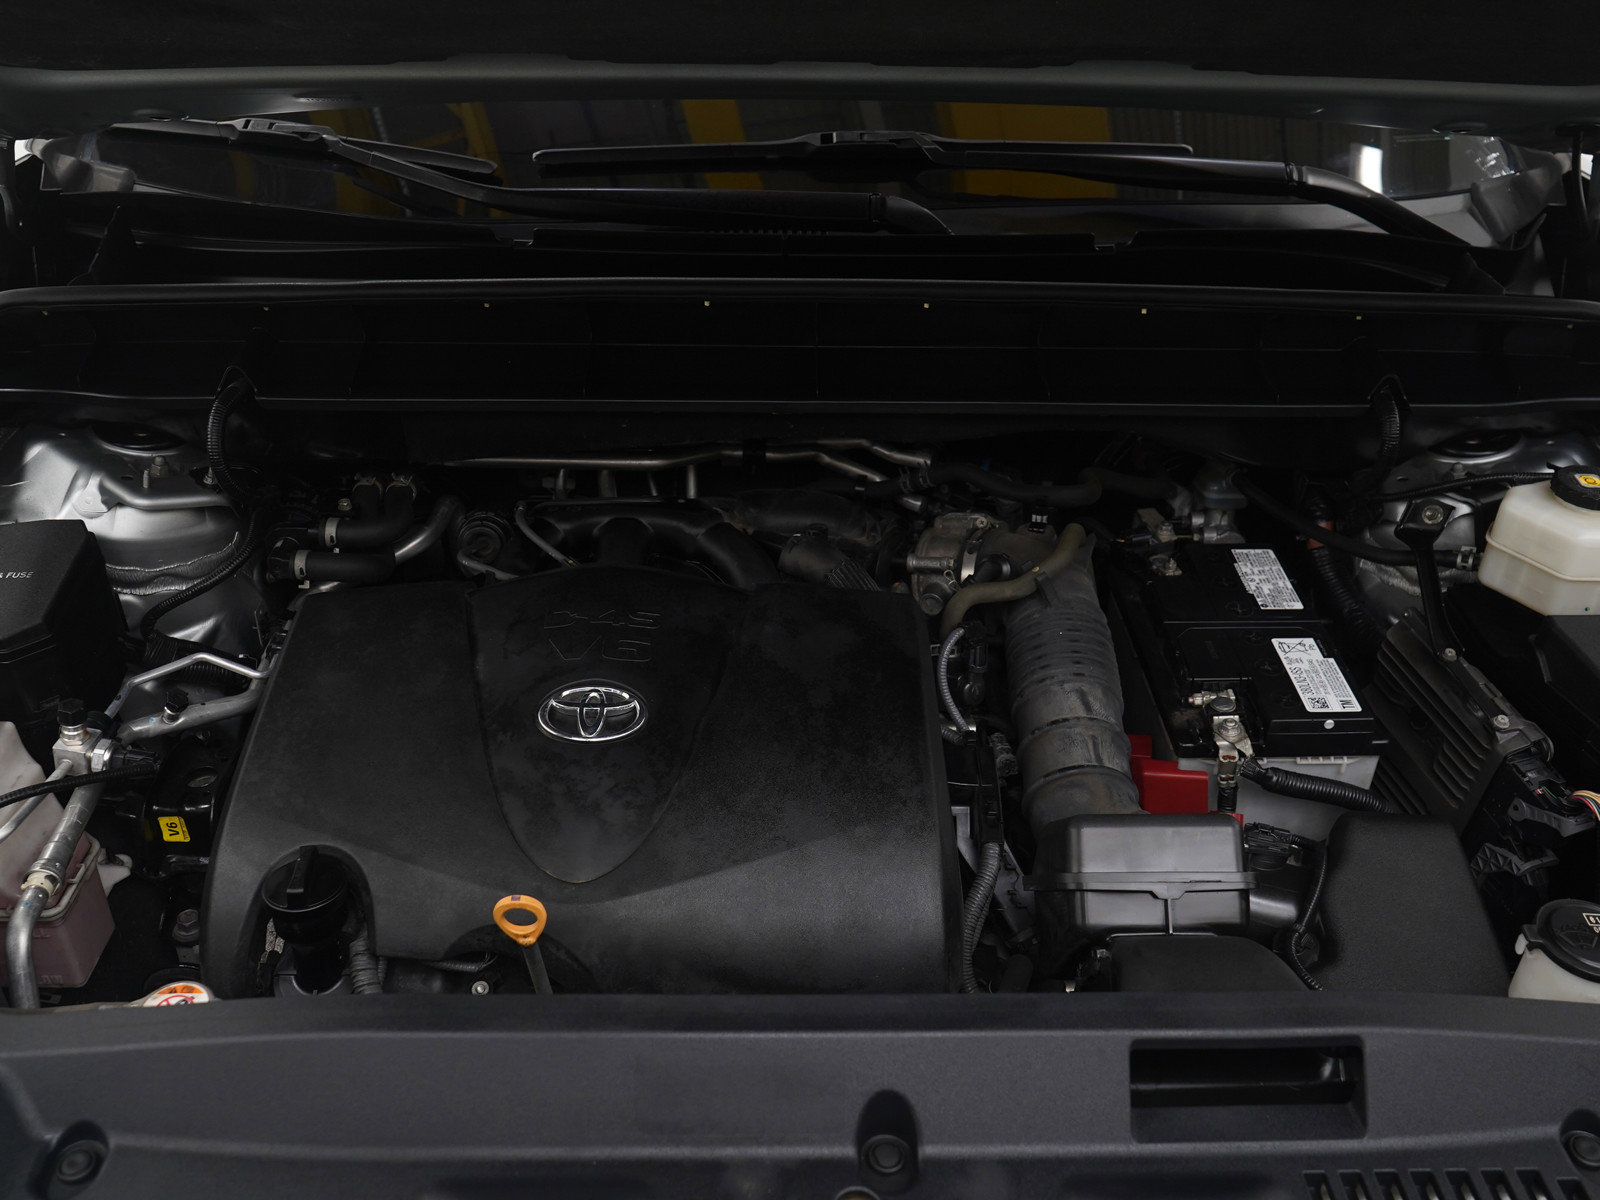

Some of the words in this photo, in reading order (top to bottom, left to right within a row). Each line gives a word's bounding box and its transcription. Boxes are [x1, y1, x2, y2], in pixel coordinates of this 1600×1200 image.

[5, 571, 34, 579] FUSE
[547, 634, 653, 663] V6
[1339, 699, 1356, 709] TM
[166, 822, 180, 837] V6
